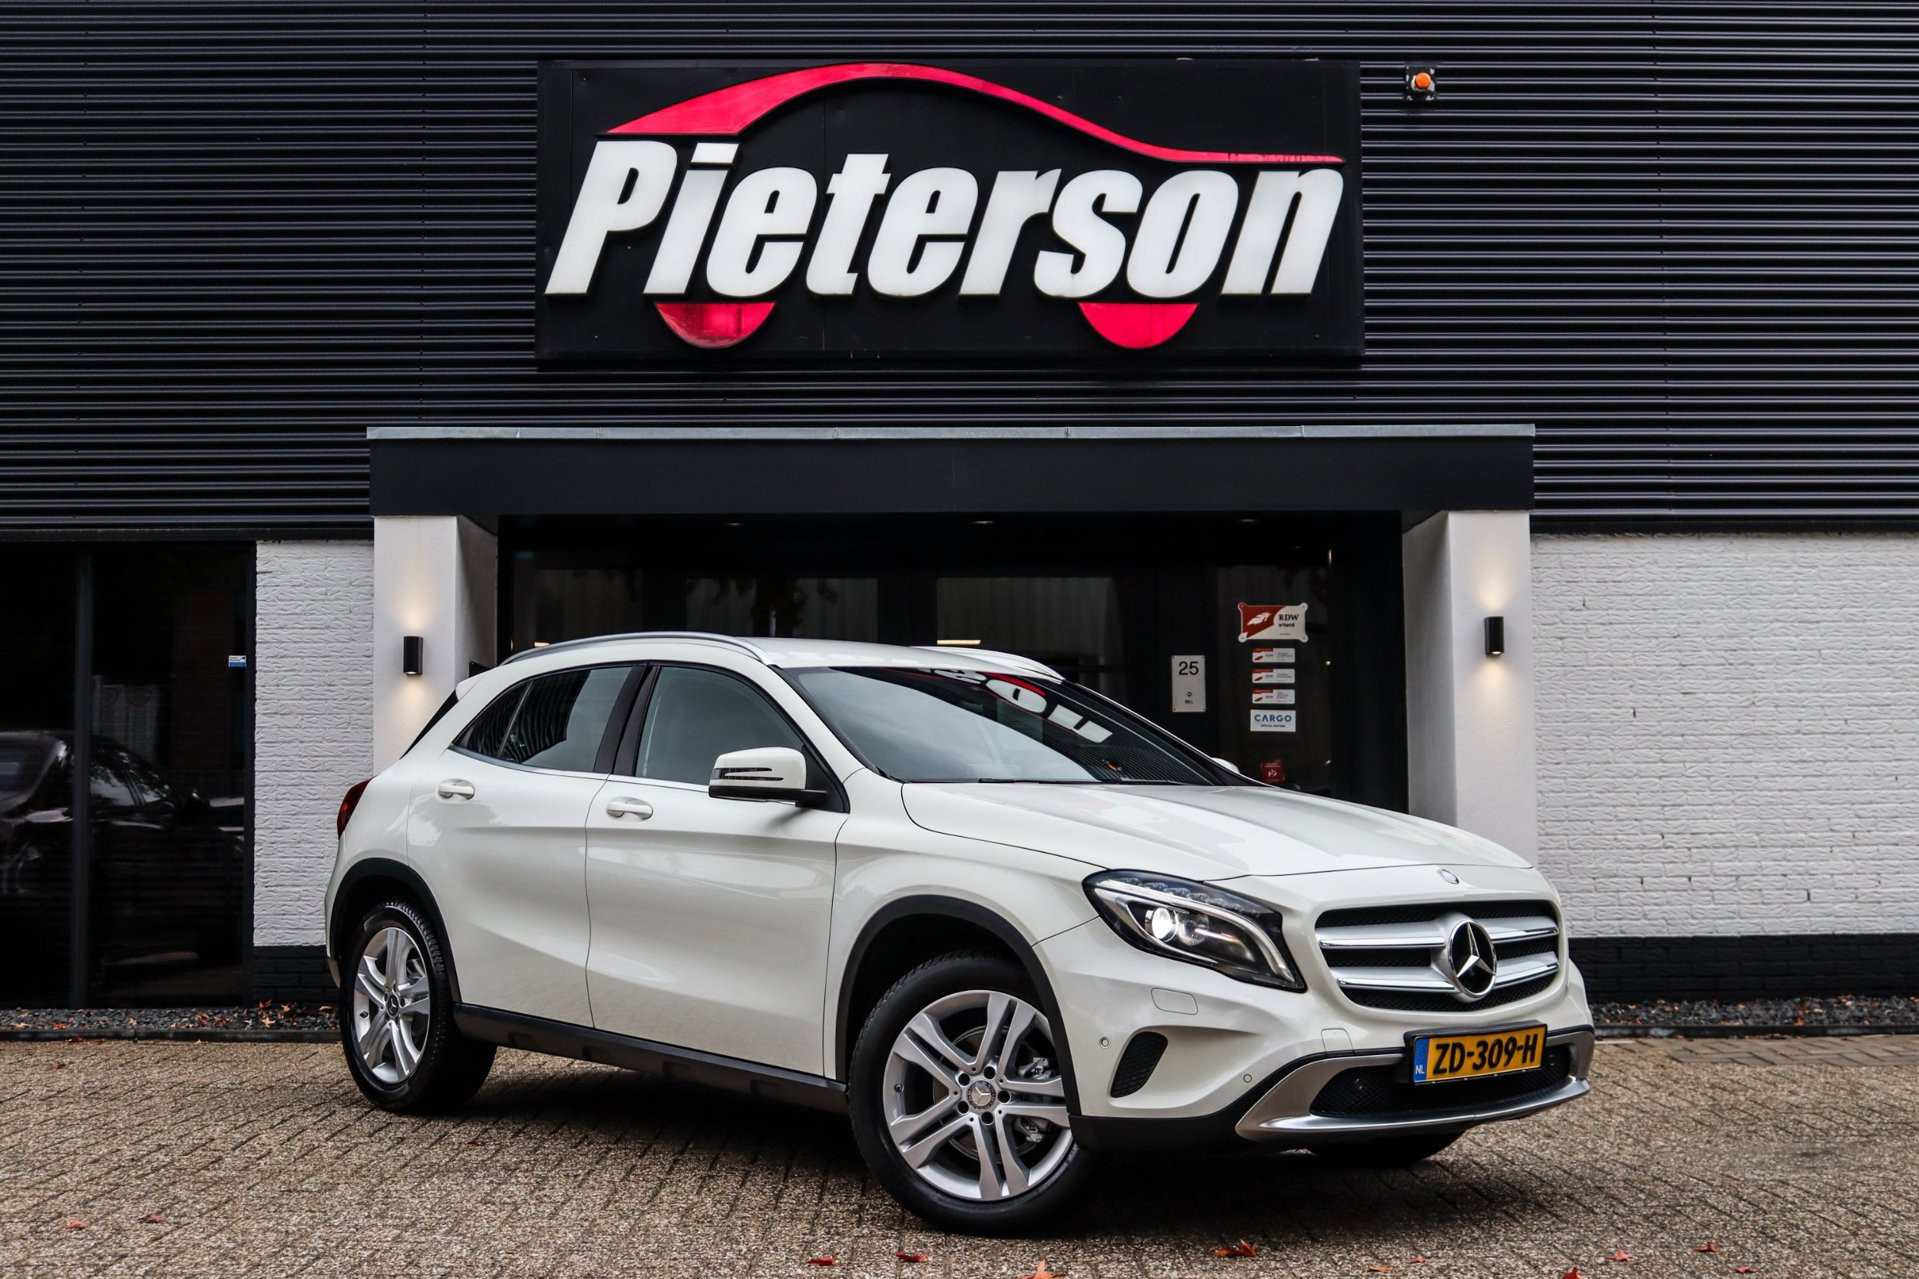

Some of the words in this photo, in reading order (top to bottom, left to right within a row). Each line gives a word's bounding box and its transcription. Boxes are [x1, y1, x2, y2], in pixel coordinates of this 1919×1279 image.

[545, 140, 1345, 299] Pieterson
[1278, 613, 1300, 622] RDW
[1178, 660, 1199, 676] 25
[1254, 714, 1293, 723] CARGO
[1432, 1033, 1539, 1076] ZD-309-H
[1415, 1064, 1425, 1075] NL
